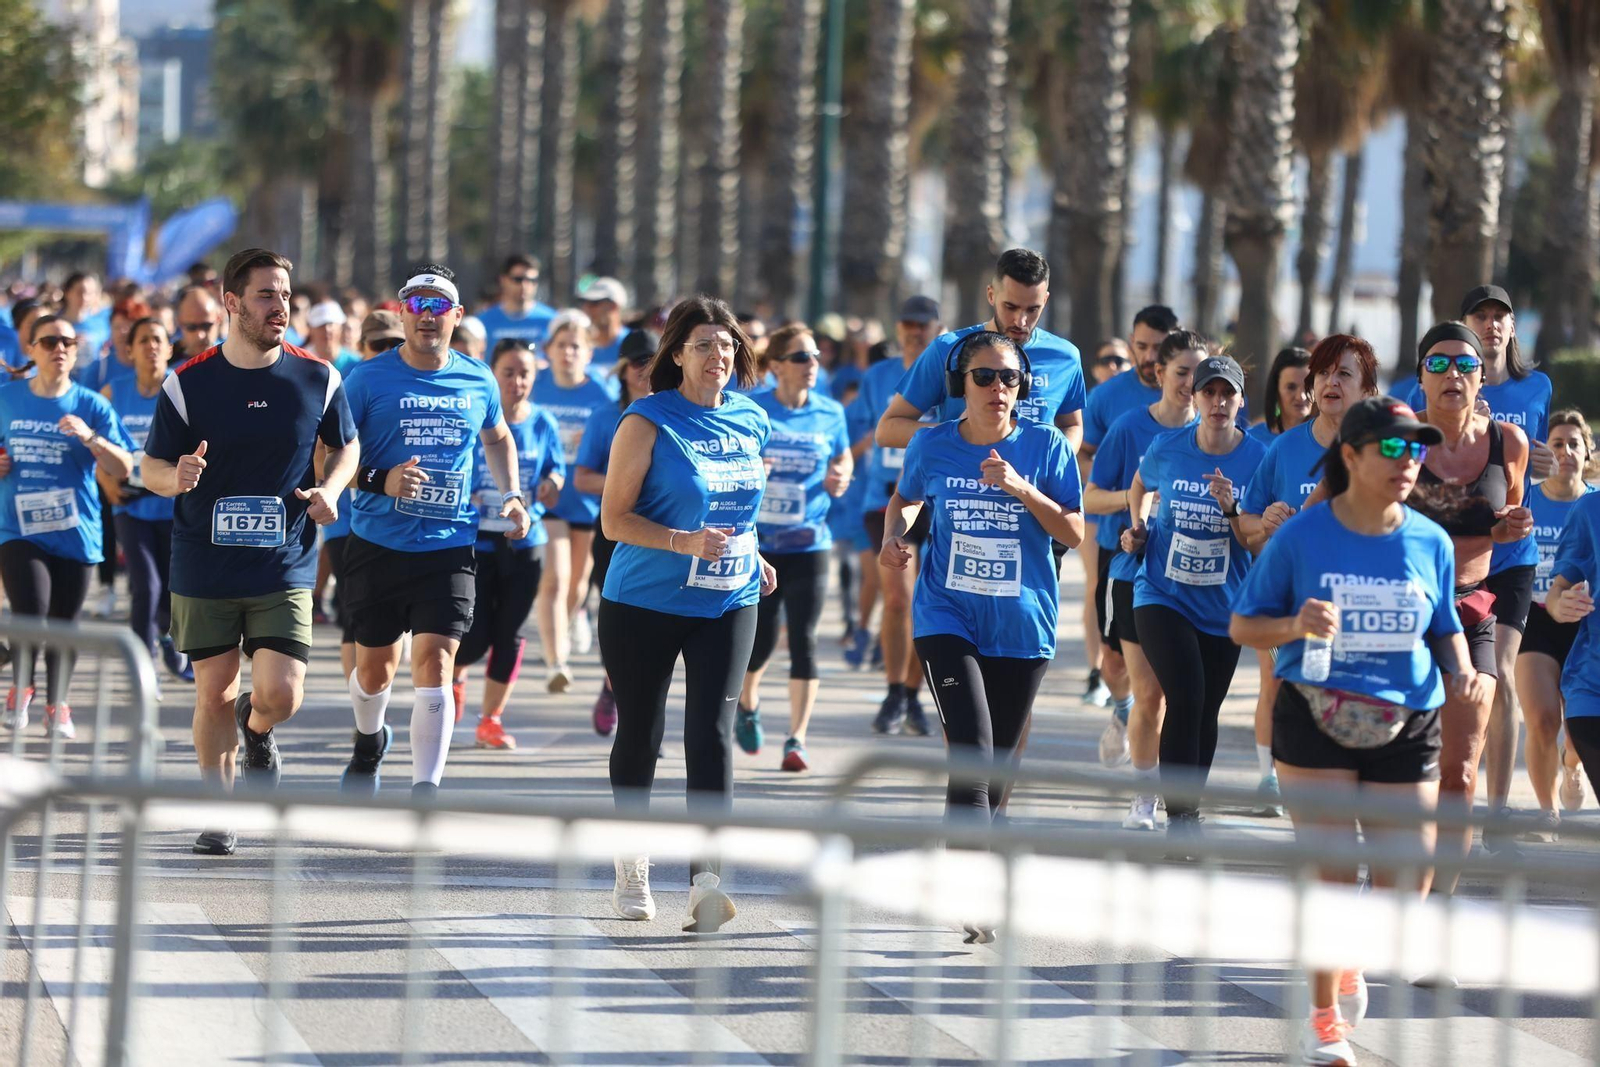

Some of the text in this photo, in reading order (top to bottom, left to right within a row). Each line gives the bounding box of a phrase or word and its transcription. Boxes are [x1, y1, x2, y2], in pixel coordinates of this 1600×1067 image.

[399, 394, 471, 411] mayoral
[399, 418, 469, 428] RUNNING
[406, 427, 462, 437] MAKES
[404, 437, 462, 446] FRIENDS
[367, 468, 378, 483] FILA
[708, 481, 763, 492] FRIENDS
[1172, 479, 1246, 499] mayal
[415, 487, 455, 504] 578
[945, 499, 1026, 513] RUNNING
[1170, 500, 1224, 516] RUNNIN
[31, 508, 65, 522] 829
[952, 510, 1019, 523] MAKES
[1175, 510, 1230, 526] MAKES
[222, 515, 276, 530] 1675
[953, 521, 1020, 531] FRIENDS
[1175, 519, 1230, 533] FRIENDS
[963, 542, 982, 550] Carrera
[963, 547, 986, 556] Solidaria
[707, 558, 745, 575] 470
[964, 558, 1006, 578] 939
[1179, 556, 1216, 572] 534
[1346, 611, 1415, 632] 1059
